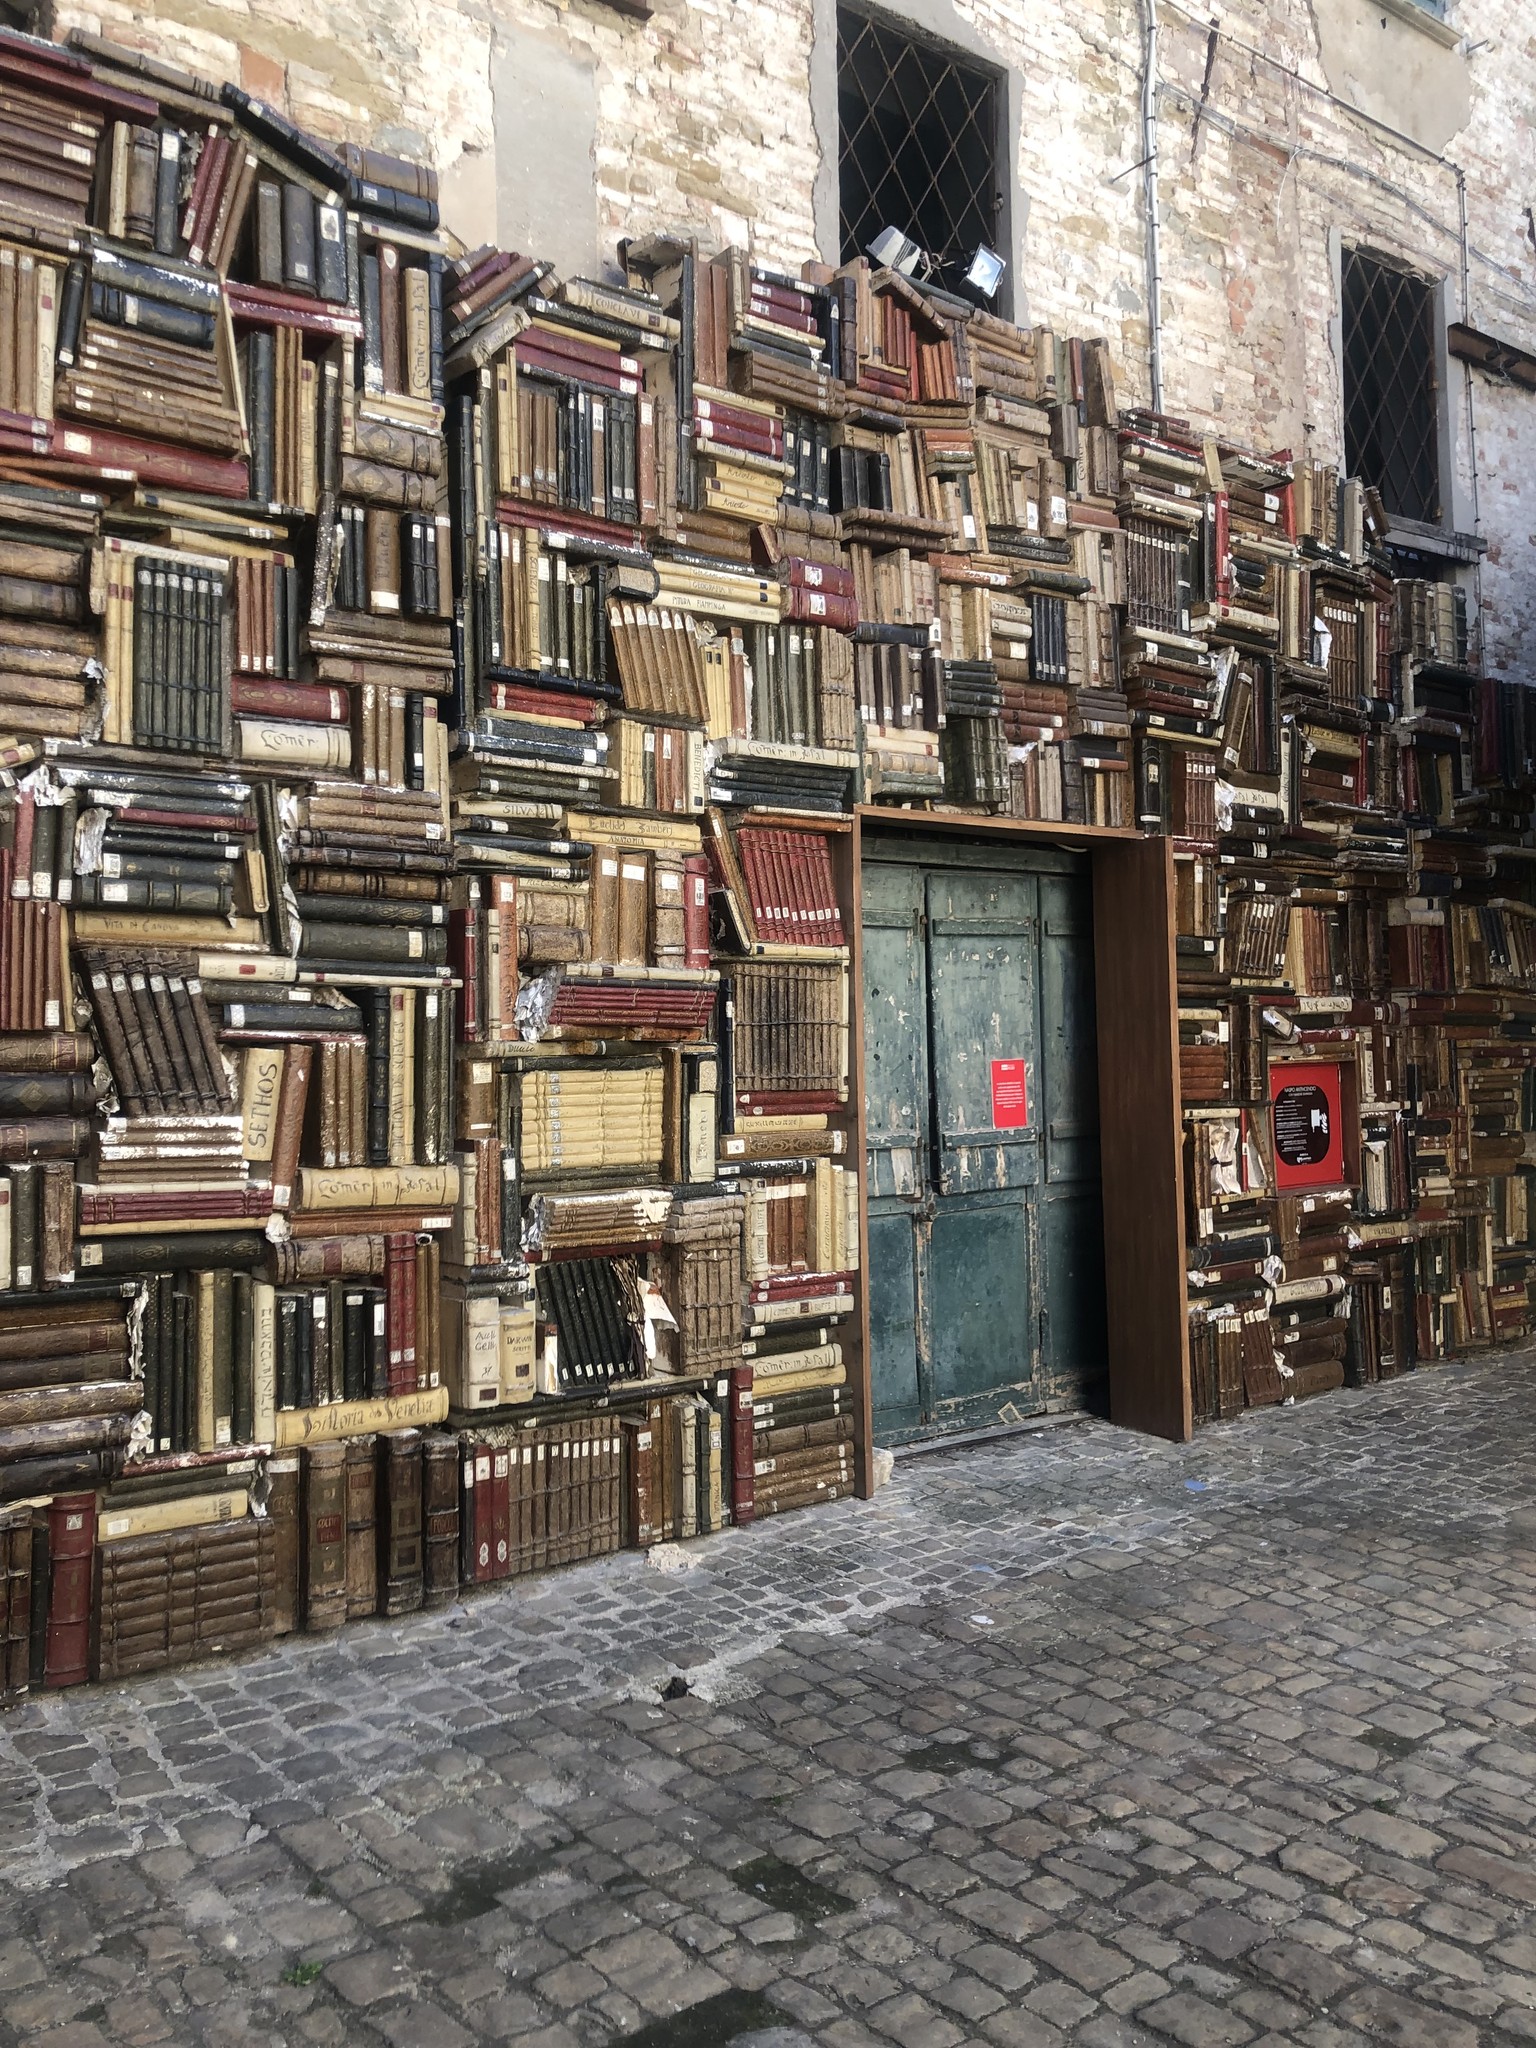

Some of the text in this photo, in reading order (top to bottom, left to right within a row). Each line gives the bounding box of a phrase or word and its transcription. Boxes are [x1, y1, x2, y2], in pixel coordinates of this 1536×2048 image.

[691, 742, 702, 791] BENEDICTI
[502, 804, 536, 816] SILVA
[248, 1062, 279, 1150] SETHOS
